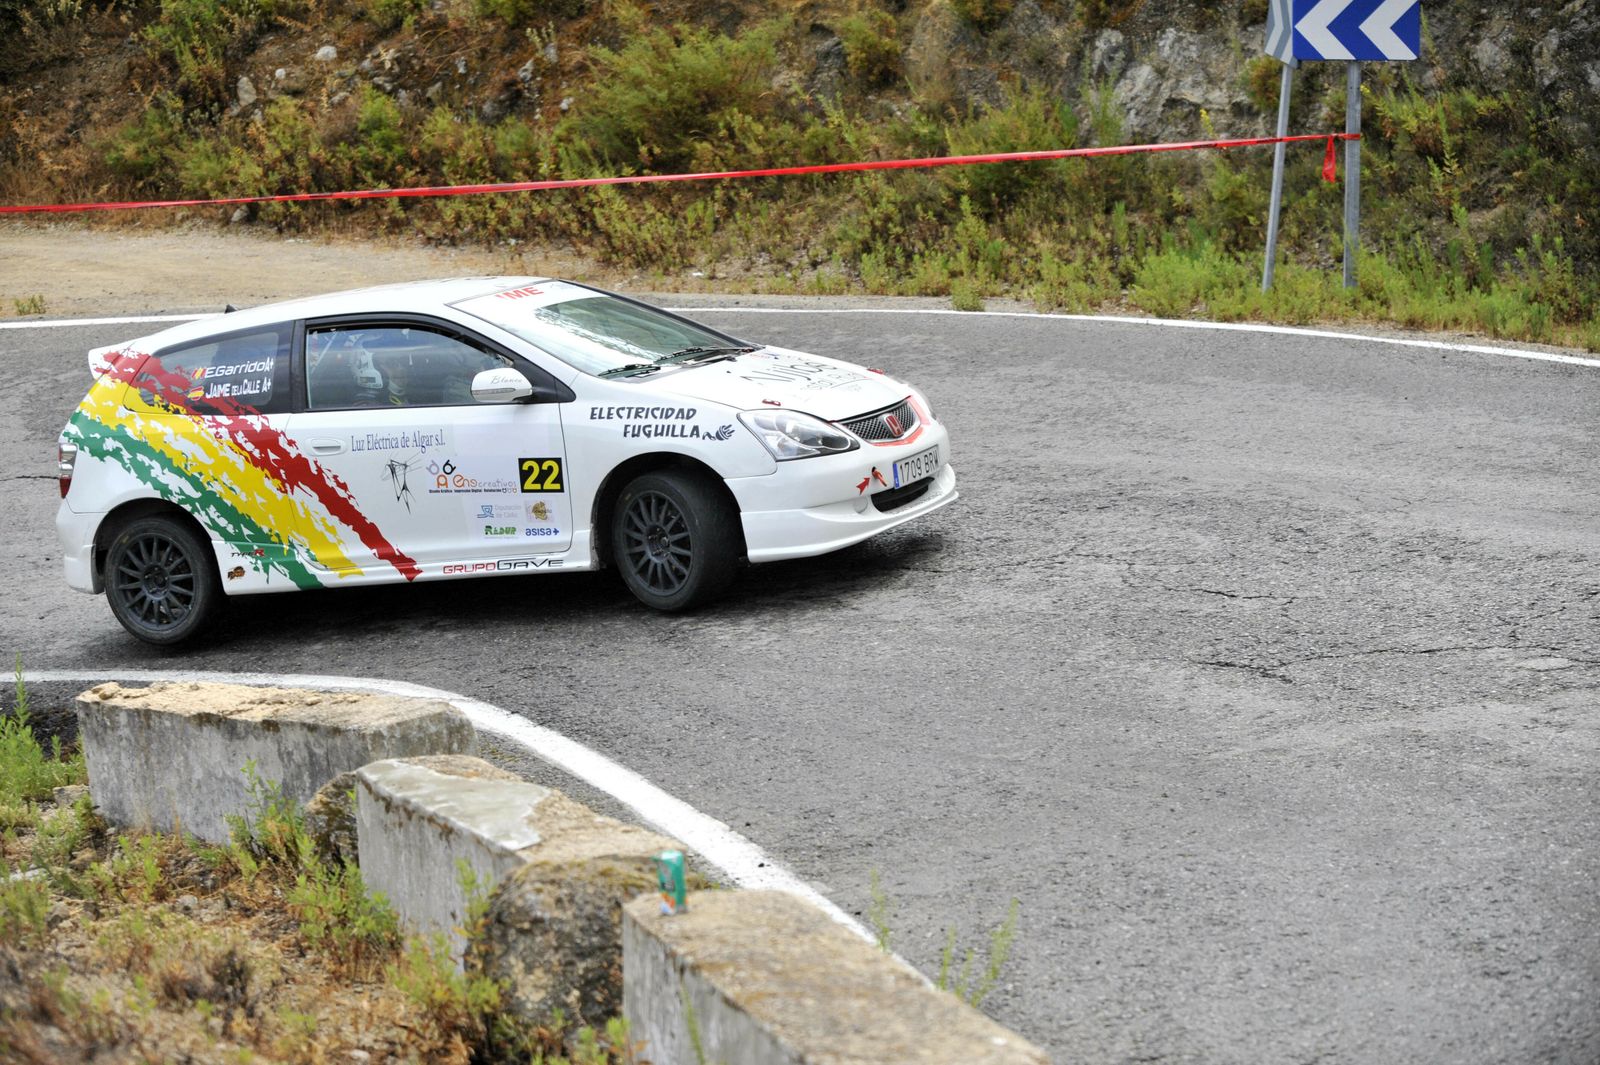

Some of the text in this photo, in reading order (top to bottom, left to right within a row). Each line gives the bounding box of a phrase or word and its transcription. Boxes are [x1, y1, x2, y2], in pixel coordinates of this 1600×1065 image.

[206, 383, 231, 399] JAIME
[589, 406, 698, 421] ELECTRICIDAD
[623, 424, 701, 439] FUGUILLA
[351, 435, 365, 452] Luz
[366, 433, 399, 451] Eléctrica
[400, 431, 410, 449] de
[412, 430, 434, 454] Algar
[521, 460, 561, 490] 22
[900, 457, 923, 484] 1709
